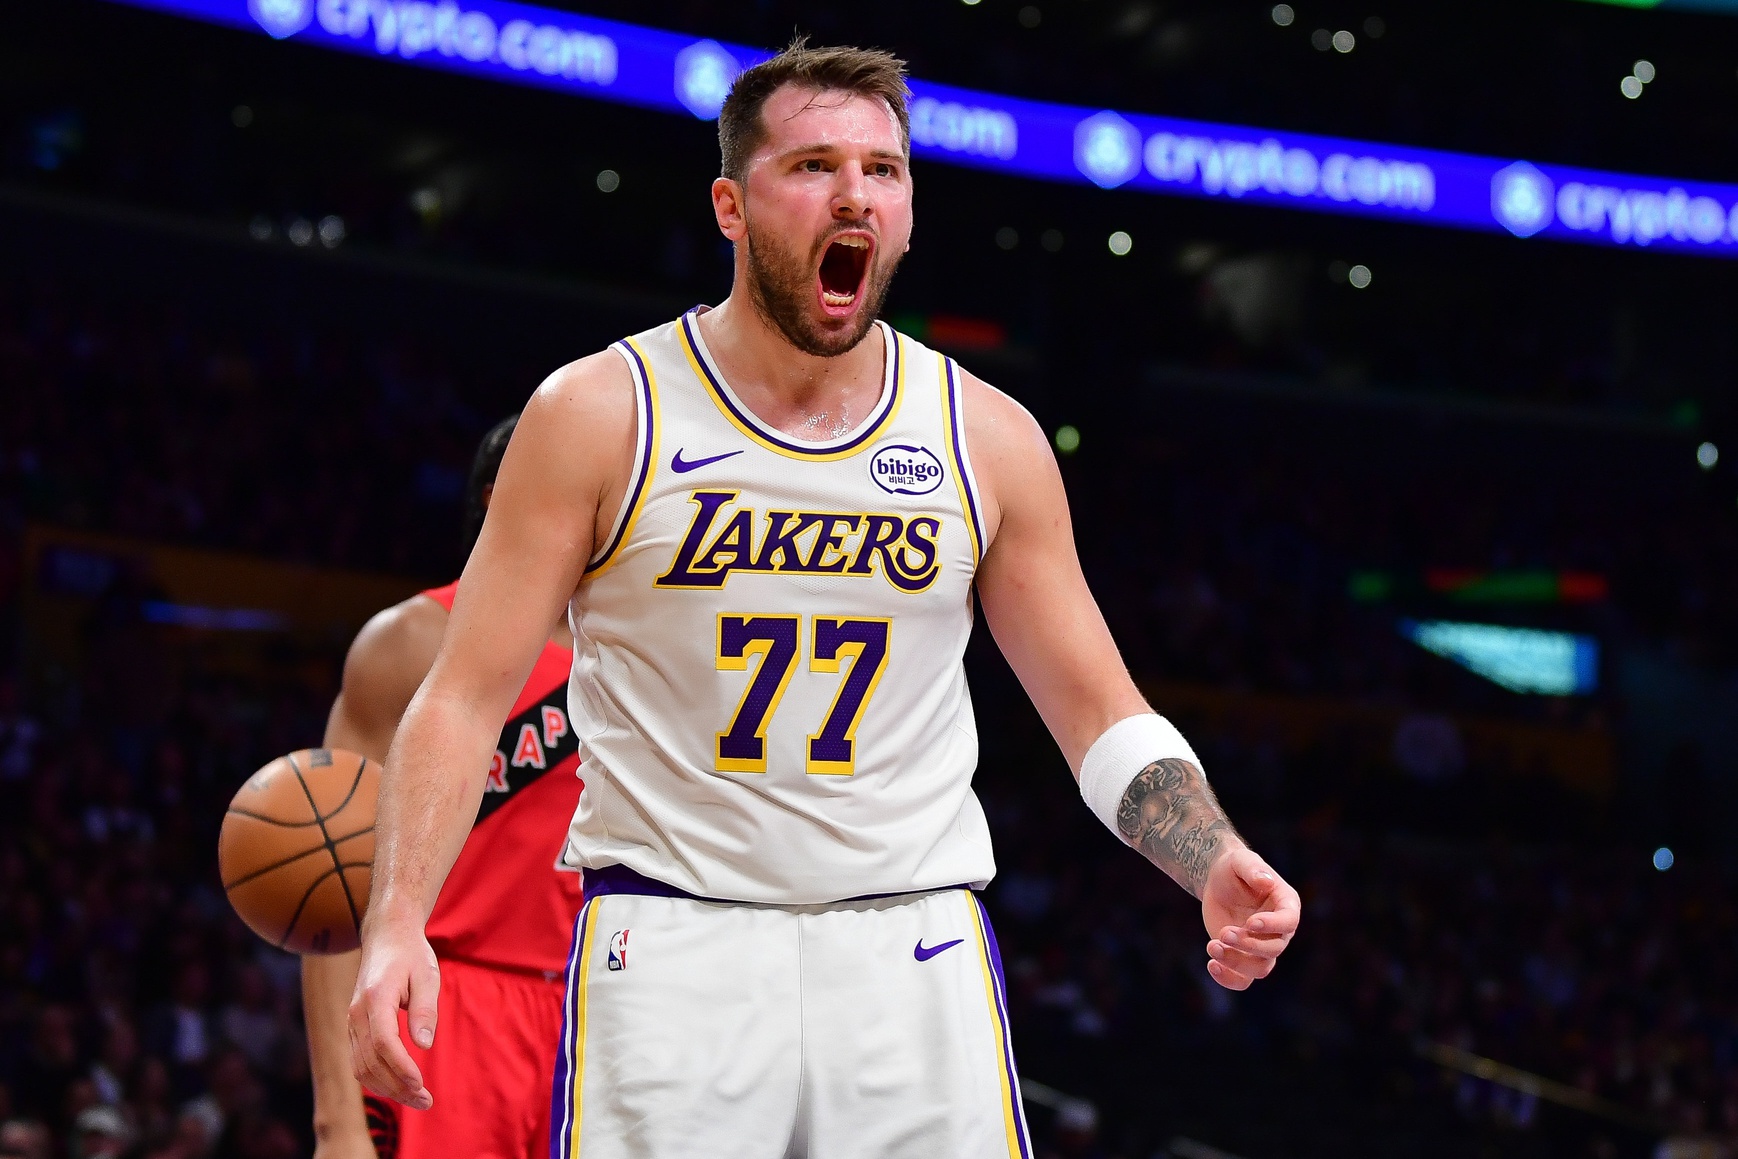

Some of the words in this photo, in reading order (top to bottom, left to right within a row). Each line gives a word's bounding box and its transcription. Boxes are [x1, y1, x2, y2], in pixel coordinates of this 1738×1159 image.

[316, 0, 618, 86] crypto.com
[1143, 132, 1436, 212] crypto.com
[1556, 182, 1738, 246] crypto.
[877, 458, 939, 482] bibigo
[889, 476, 915, 485] 비비고
[652, 489, 942, 594] LAKERS
[715, 612, 892, 775] 77
[484, 704, 567, 792] RAP
